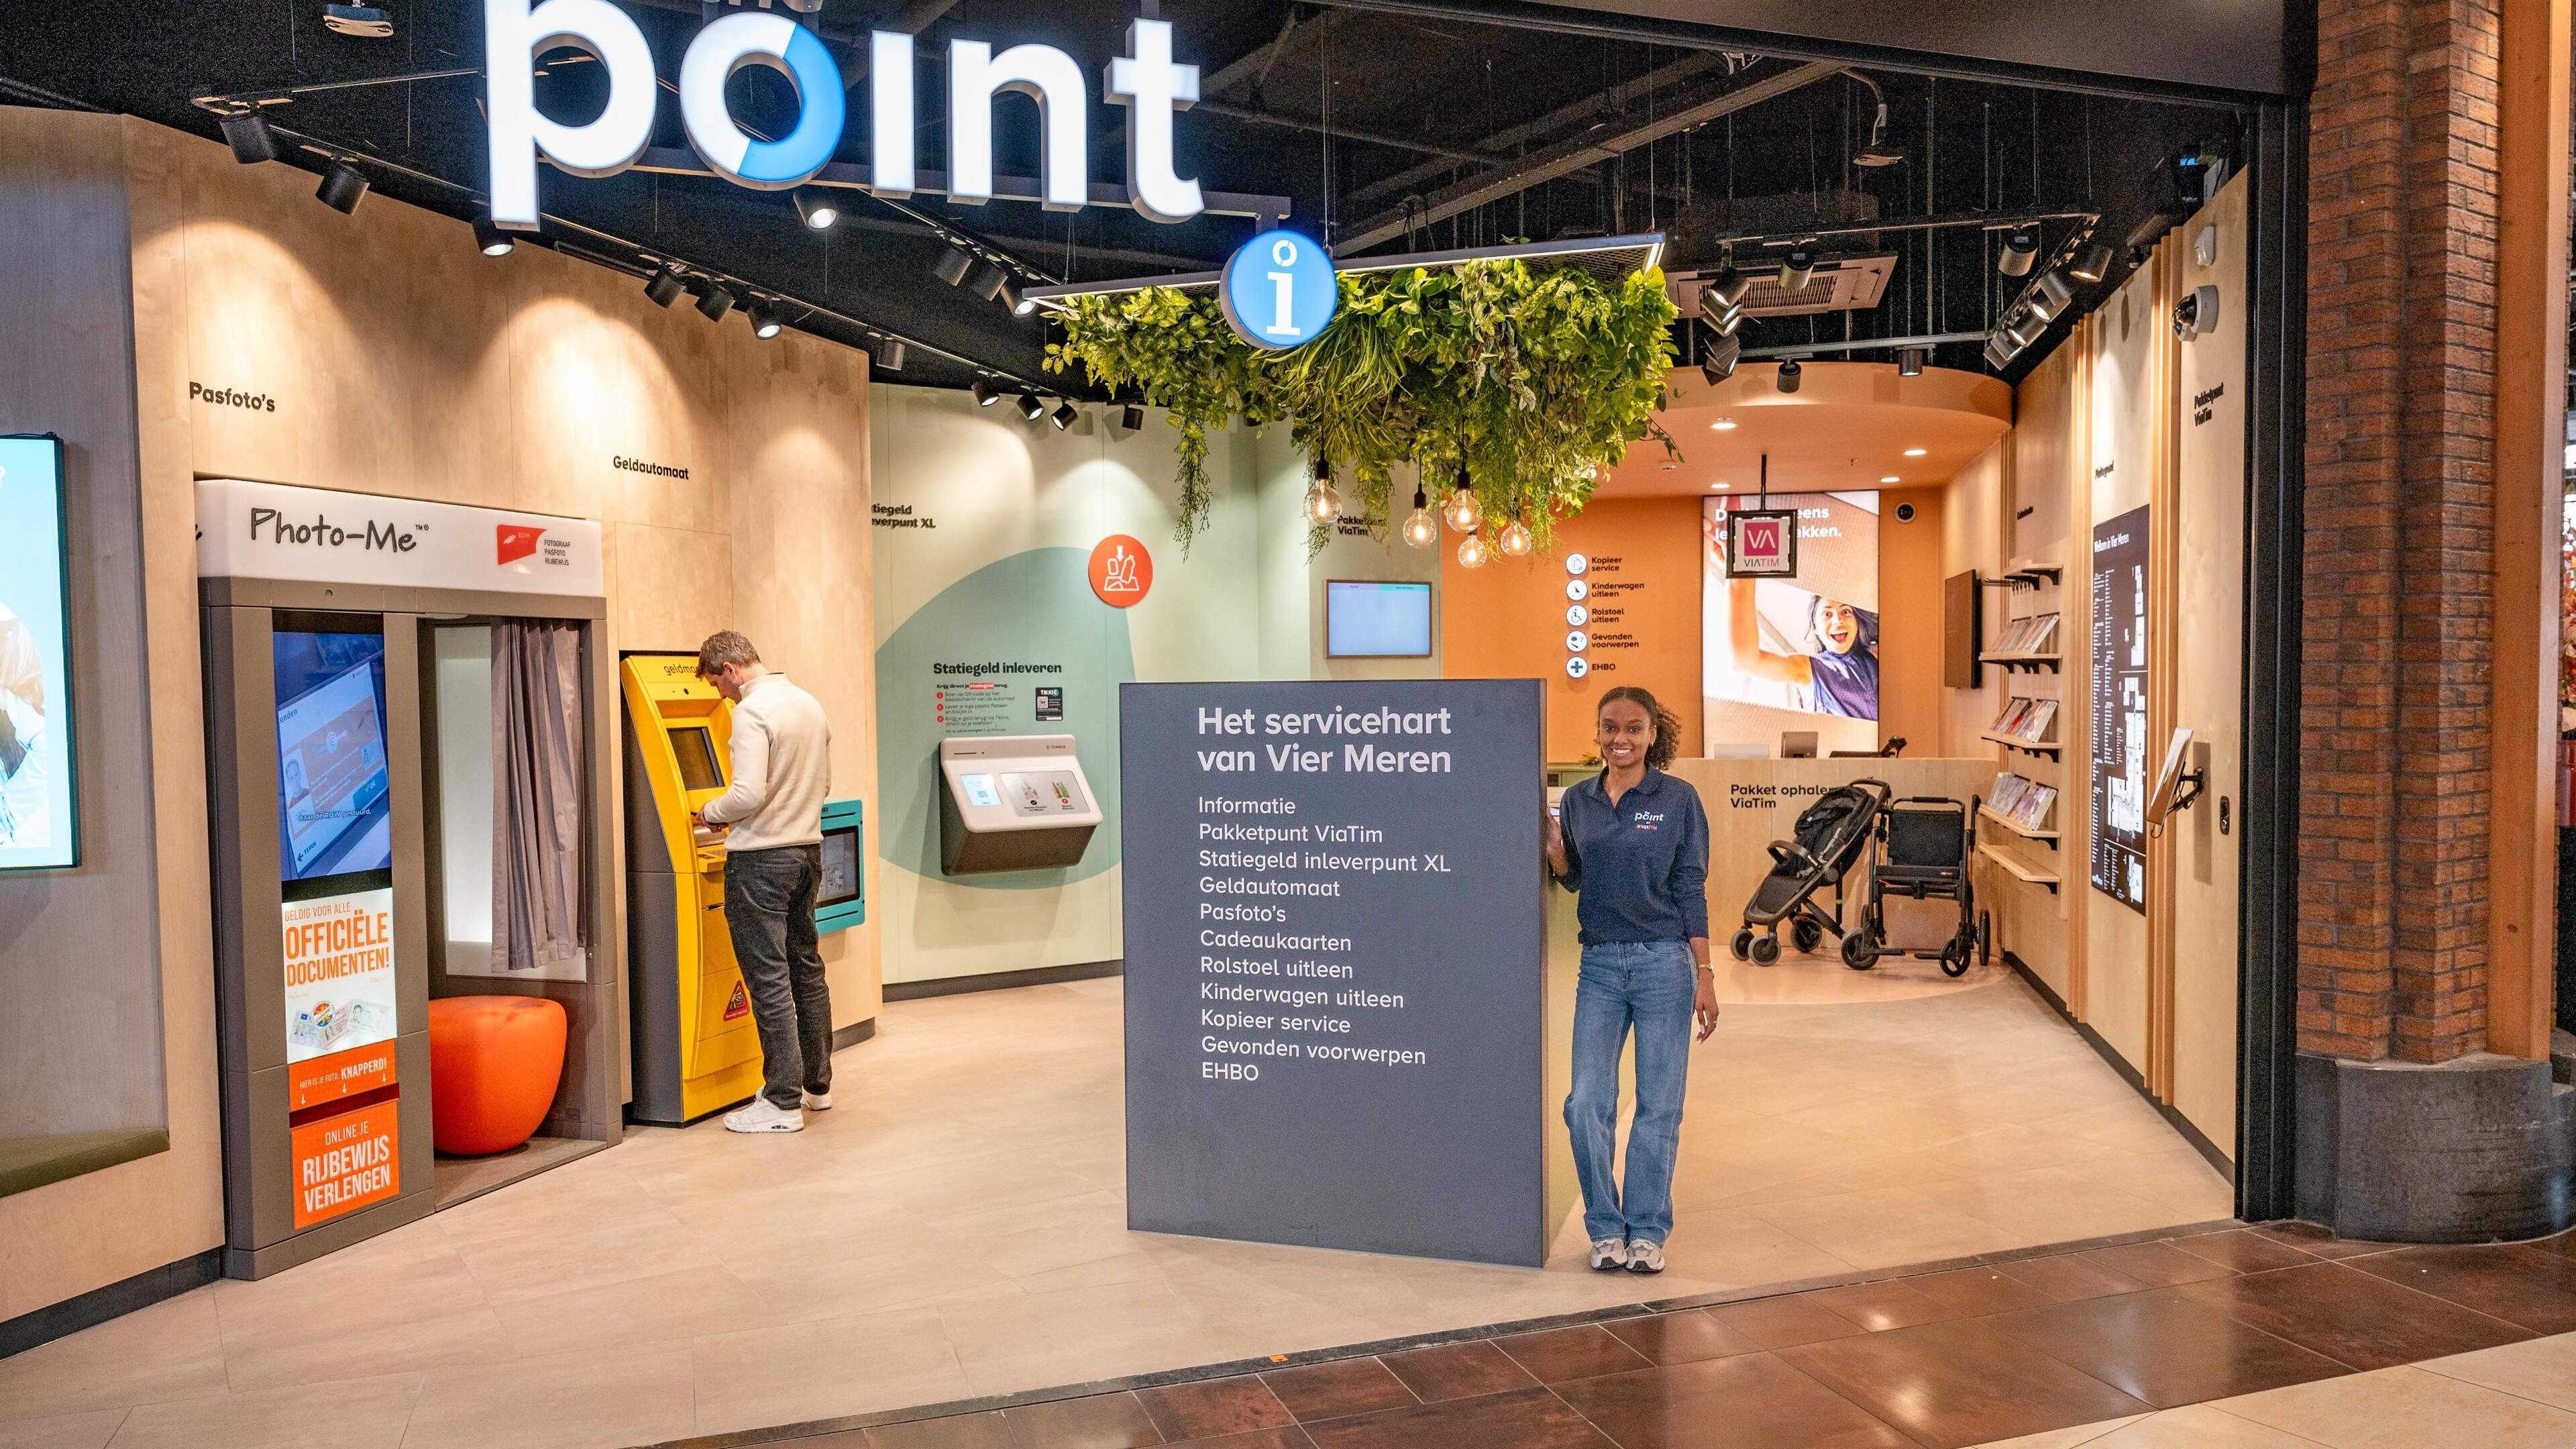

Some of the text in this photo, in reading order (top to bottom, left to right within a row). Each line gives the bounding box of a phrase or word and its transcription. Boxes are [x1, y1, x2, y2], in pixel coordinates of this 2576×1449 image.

[484, 0, 1204, 229] point
[190, 381, 276, 413] Pasfoto's
[613, 455, 689, 480] Geldautomaat
[871, 503, 912, 517] tiegeld
[251, 507, 417, 553] Photo-Me
[920, 518, 936, 529] XL
[1338, 525, 1368, 536] ViaTim
[544, 539, 571, 548] FOTOGRAAF
[545, 557, 570, 566] RIJBEWIJS
[1591, 557, 1622, 565] Kopieer
[1744, 558, 1779, 568] VIATIM
[1591, 582, 1644, 590] Kinderwagen
[1591, 608, 1625, 616] Rolstoel
[663, 663, 698, 676] geldma
[933, 662, 1062, 677] Statiegeld inleveren
[1591, 663, 1616, 671] EHBO
[1198, 704, 1452, 735] Het servicehart
[1197, 743, 1452, 773] van Vier Meren
[1731, 784, 1776, 795] Pakket
[342, 808, 372, 818] gestuurd.
[1198, 796, 1296, 815] Informatie
[1731, 798, 1776, 808] ViaTim
[1199, 822, 1383, 845] Pakketpunt ViaTim
[1199, 849, 1451, 875] Statiegeld inleverpunt XL
[1199, 875, 1340, 898] Geldautomaat
[284, 902, 352, 922] GELDIG VOOR ALLE
[1199, 903, 1287, 922] Pasfoto's
[285, 908, 389, 959] OFFICIËLE
[1200, 929, 1352, 952] Cadeaukaarten
[286, 947, 390, 988] DOCUMENTEN!
[1201, 956, 1354, 979] Rolstoel uitleen
[1201, 982, 1405, 1009] Kinderwagen uitleen
[1201, 1009, 1351, 1033] Kopieer service
[1201, 1035, 1426, 1067] Gevonden voorwerpen
[299, 1057, 387, 1089] HIER IS JE FOTO KNAPPERD!
[1201, 1061, 1259, 1081] EHBO
[325, 1120, 369, 1146] ONLINE JE
[303, 1134, 390, 1186] RIJBEWIJS
[304, 1163, 390, 1214] VERLENGEN
